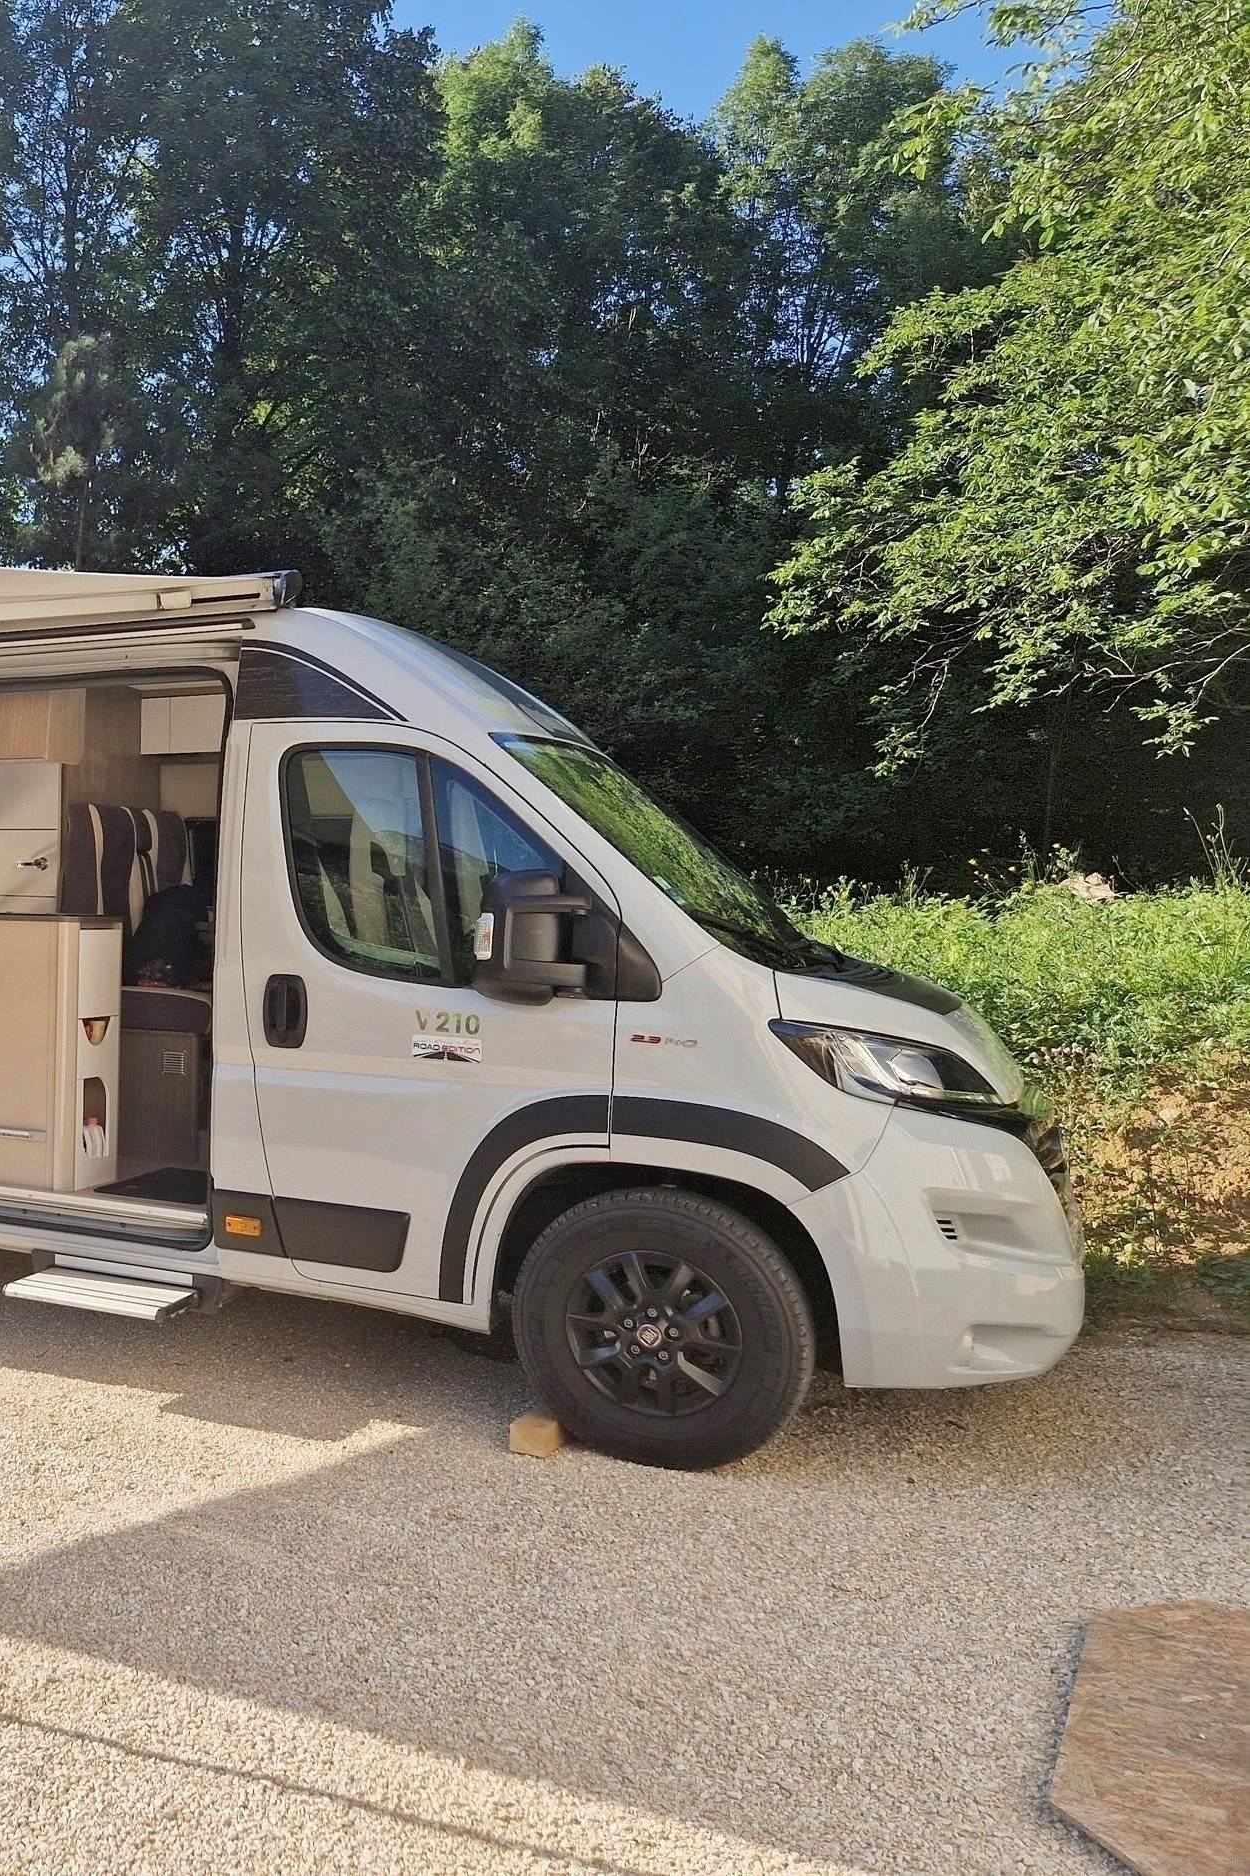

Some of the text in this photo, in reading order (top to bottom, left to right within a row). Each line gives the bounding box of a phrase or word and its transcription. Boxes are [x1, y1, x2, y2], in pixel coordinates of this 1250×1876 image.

[415, 1010, 480, 1035] V 210
[413, 1042, 441, 1051] ROAD
